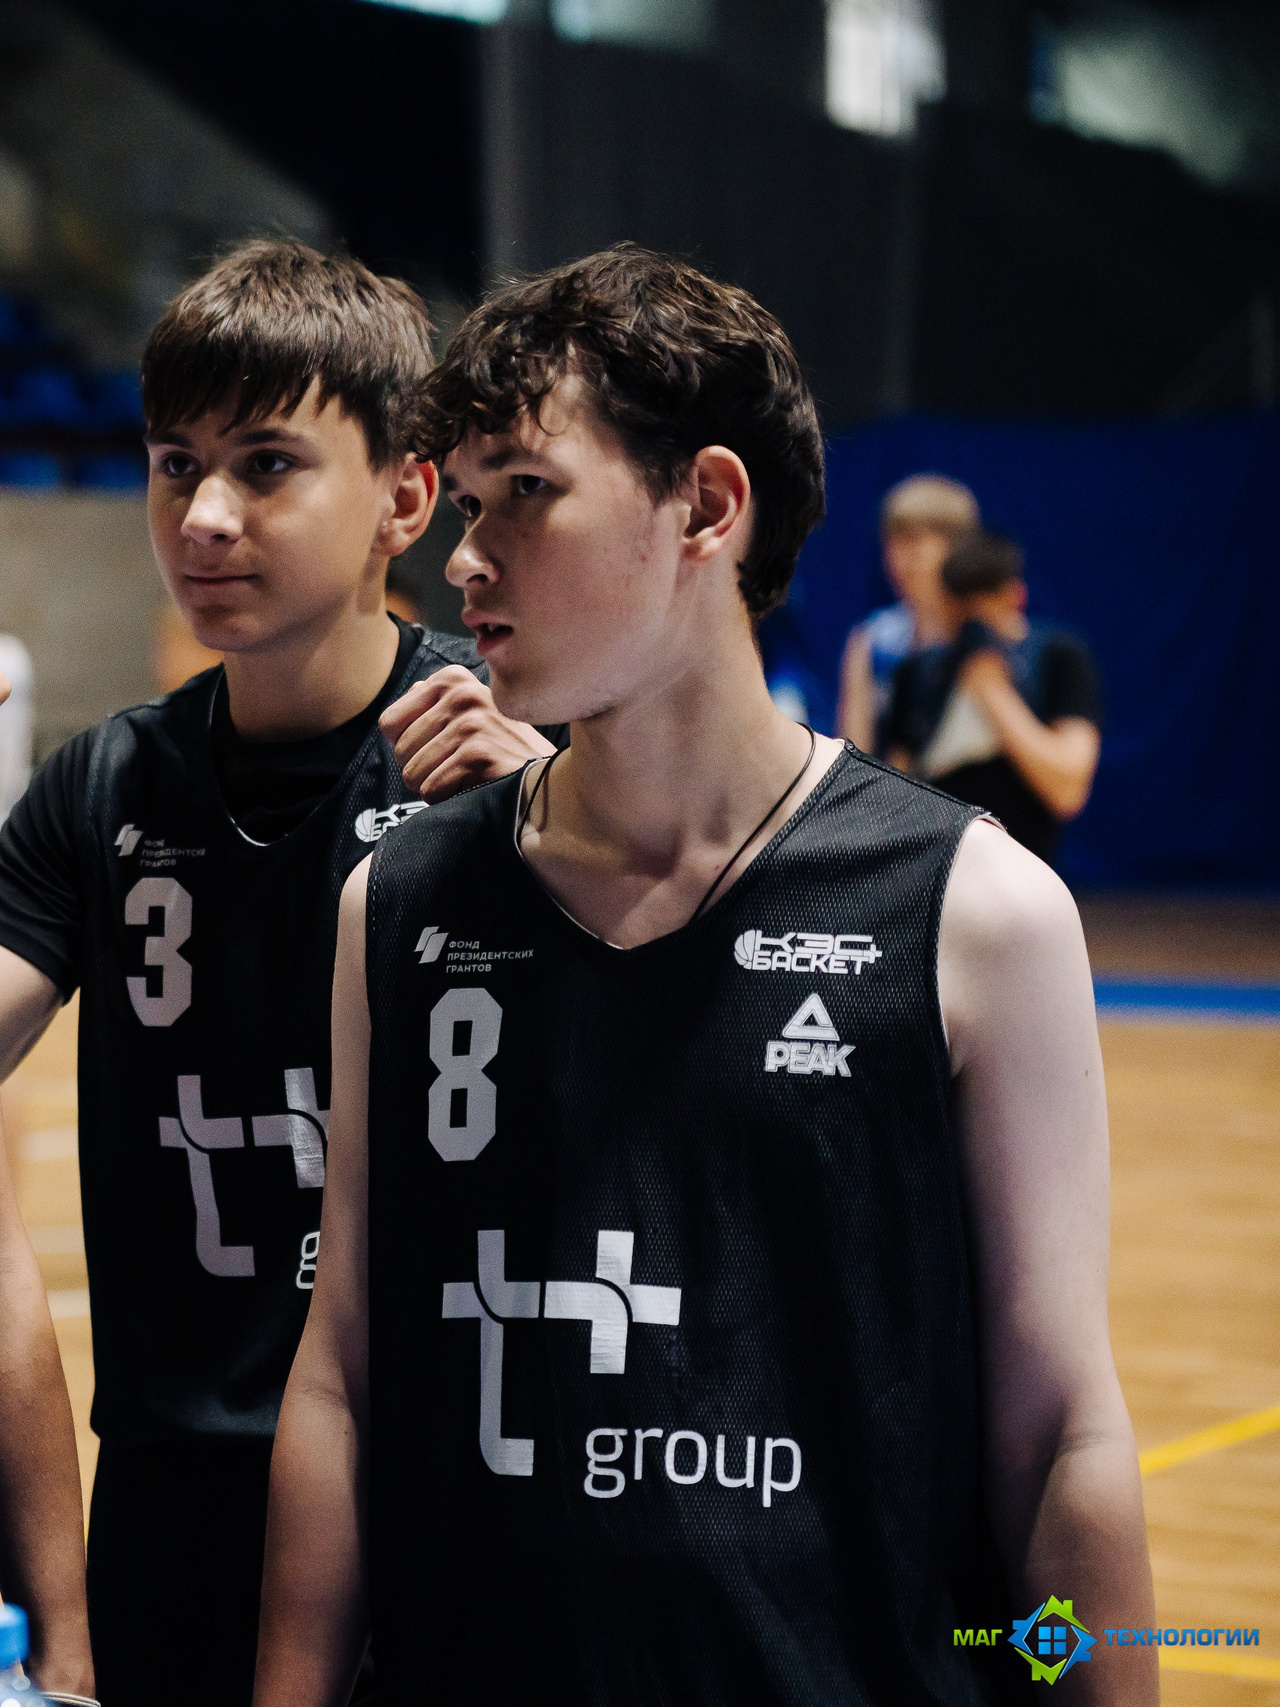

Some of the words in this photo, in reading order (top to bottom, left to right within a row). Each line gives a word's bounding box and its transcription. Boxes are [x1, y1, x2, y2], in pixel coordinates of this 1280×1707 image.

[125, 877, 193, 1027] 3
[447, 949, 534, 961] ПРЕЗИДЕНТСКИХ
[448, 940, 480, 950] ФОНД
[446, 963, 492, 974] ГРАНТОВ
[752, 951, 870, 975] БАСКЕТ
[428, 987, 503, 1162] 8
[765, 1040, 857, 1078] PEAK
[584, 1427, 802, 1508] group
